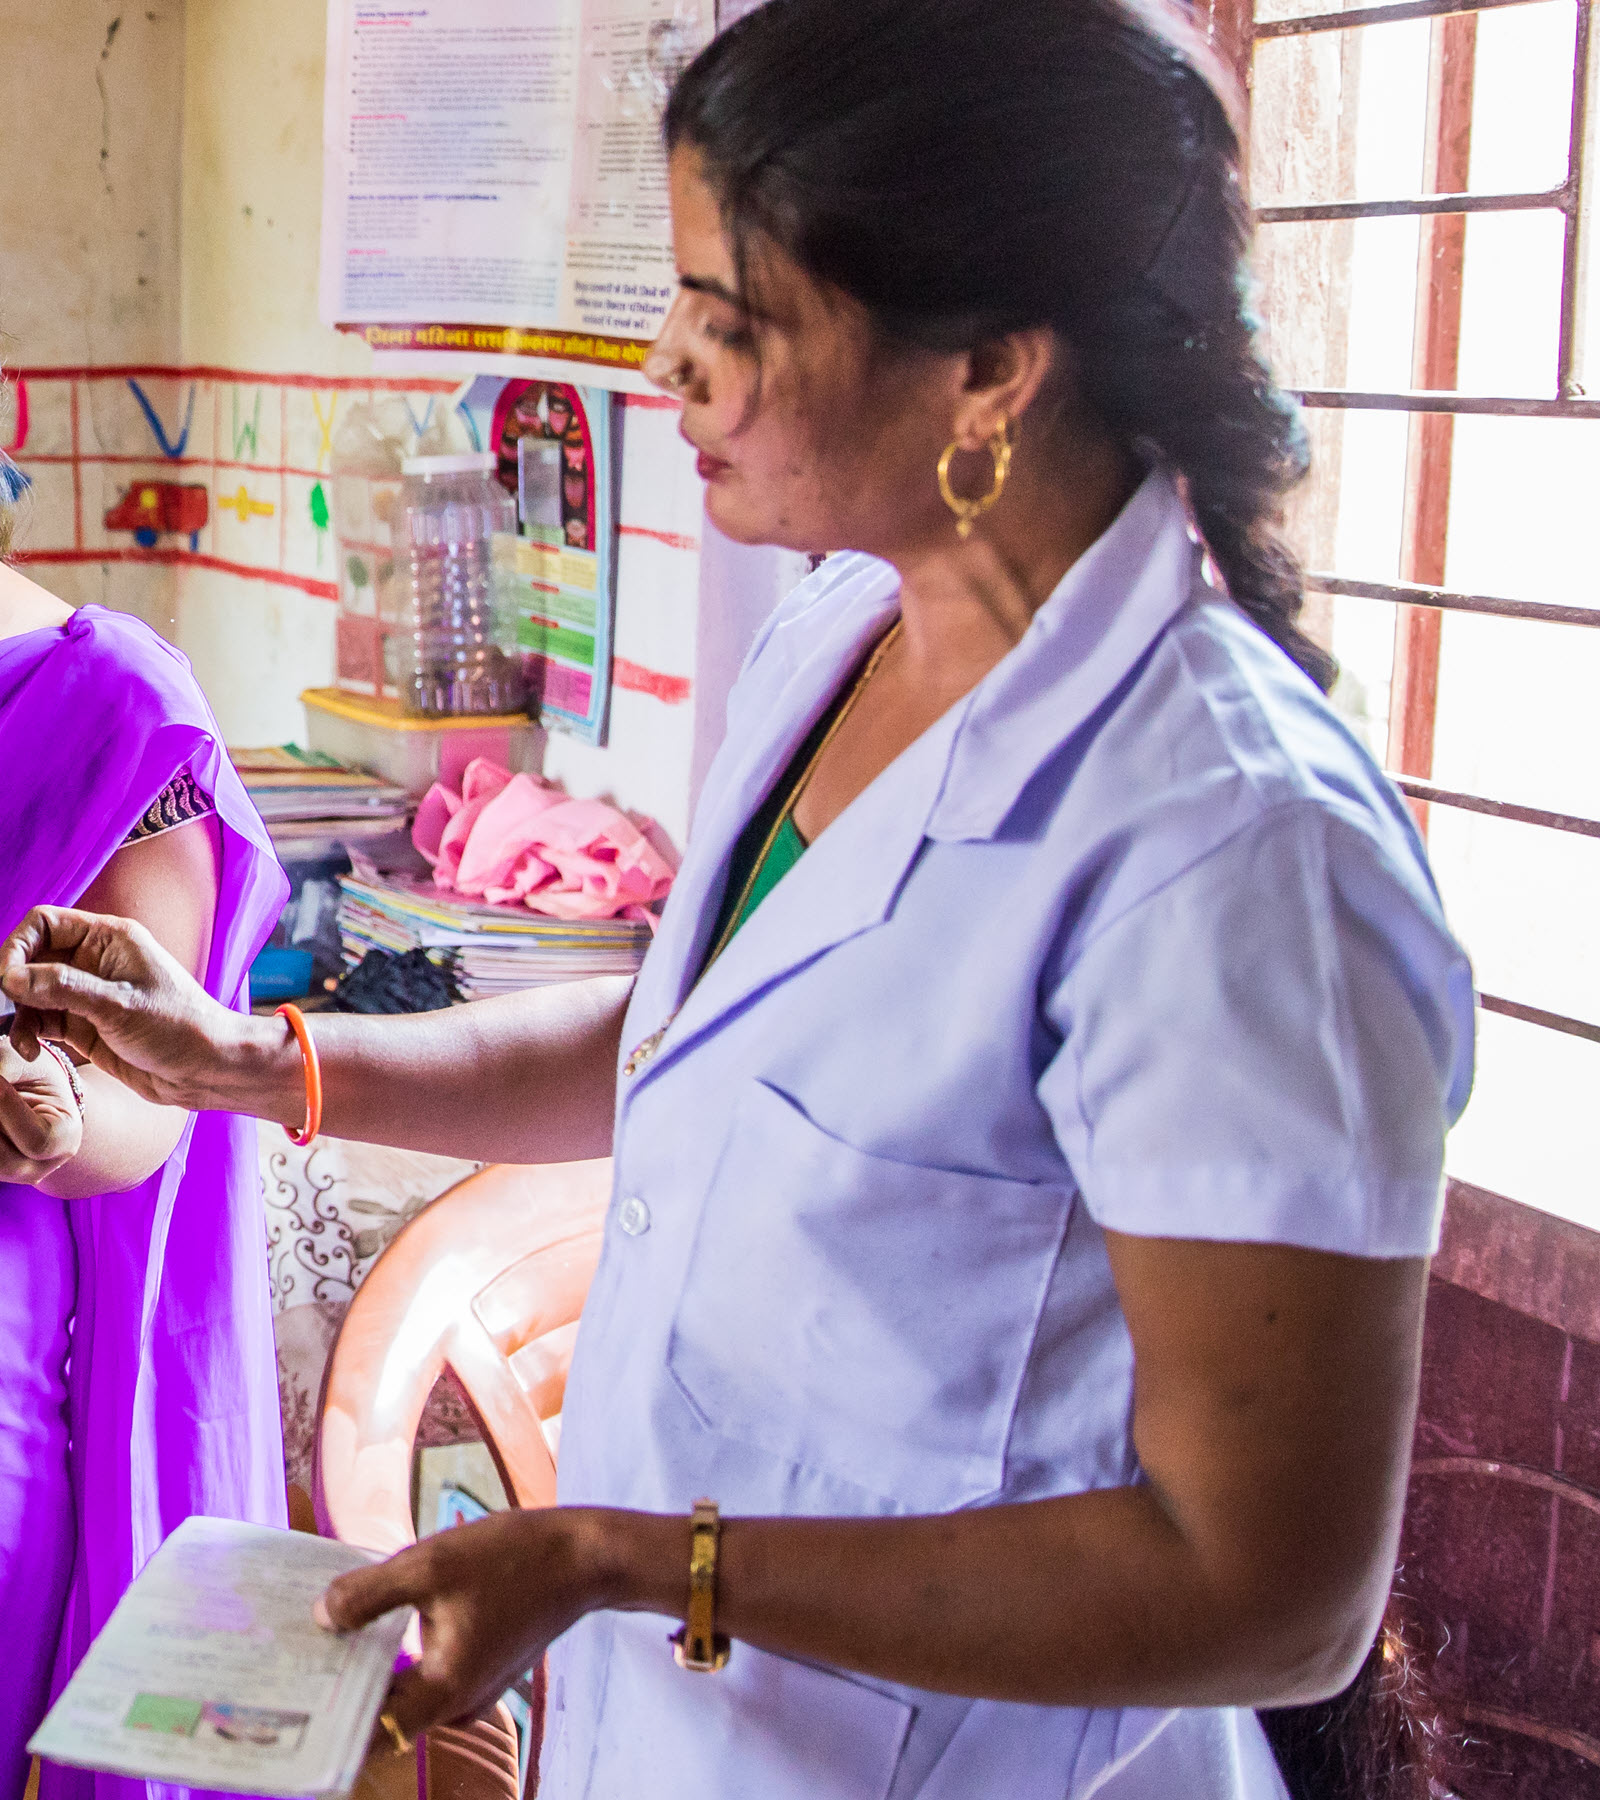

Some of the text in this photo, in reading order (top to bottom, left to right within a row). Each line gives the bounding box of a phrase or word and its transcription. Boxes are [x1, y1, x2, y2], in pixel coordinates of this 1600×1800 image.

[365, 325, 411, 345] जिला
[415, 325, 469, 346] महिला
[127, 379, 196, 458] V
